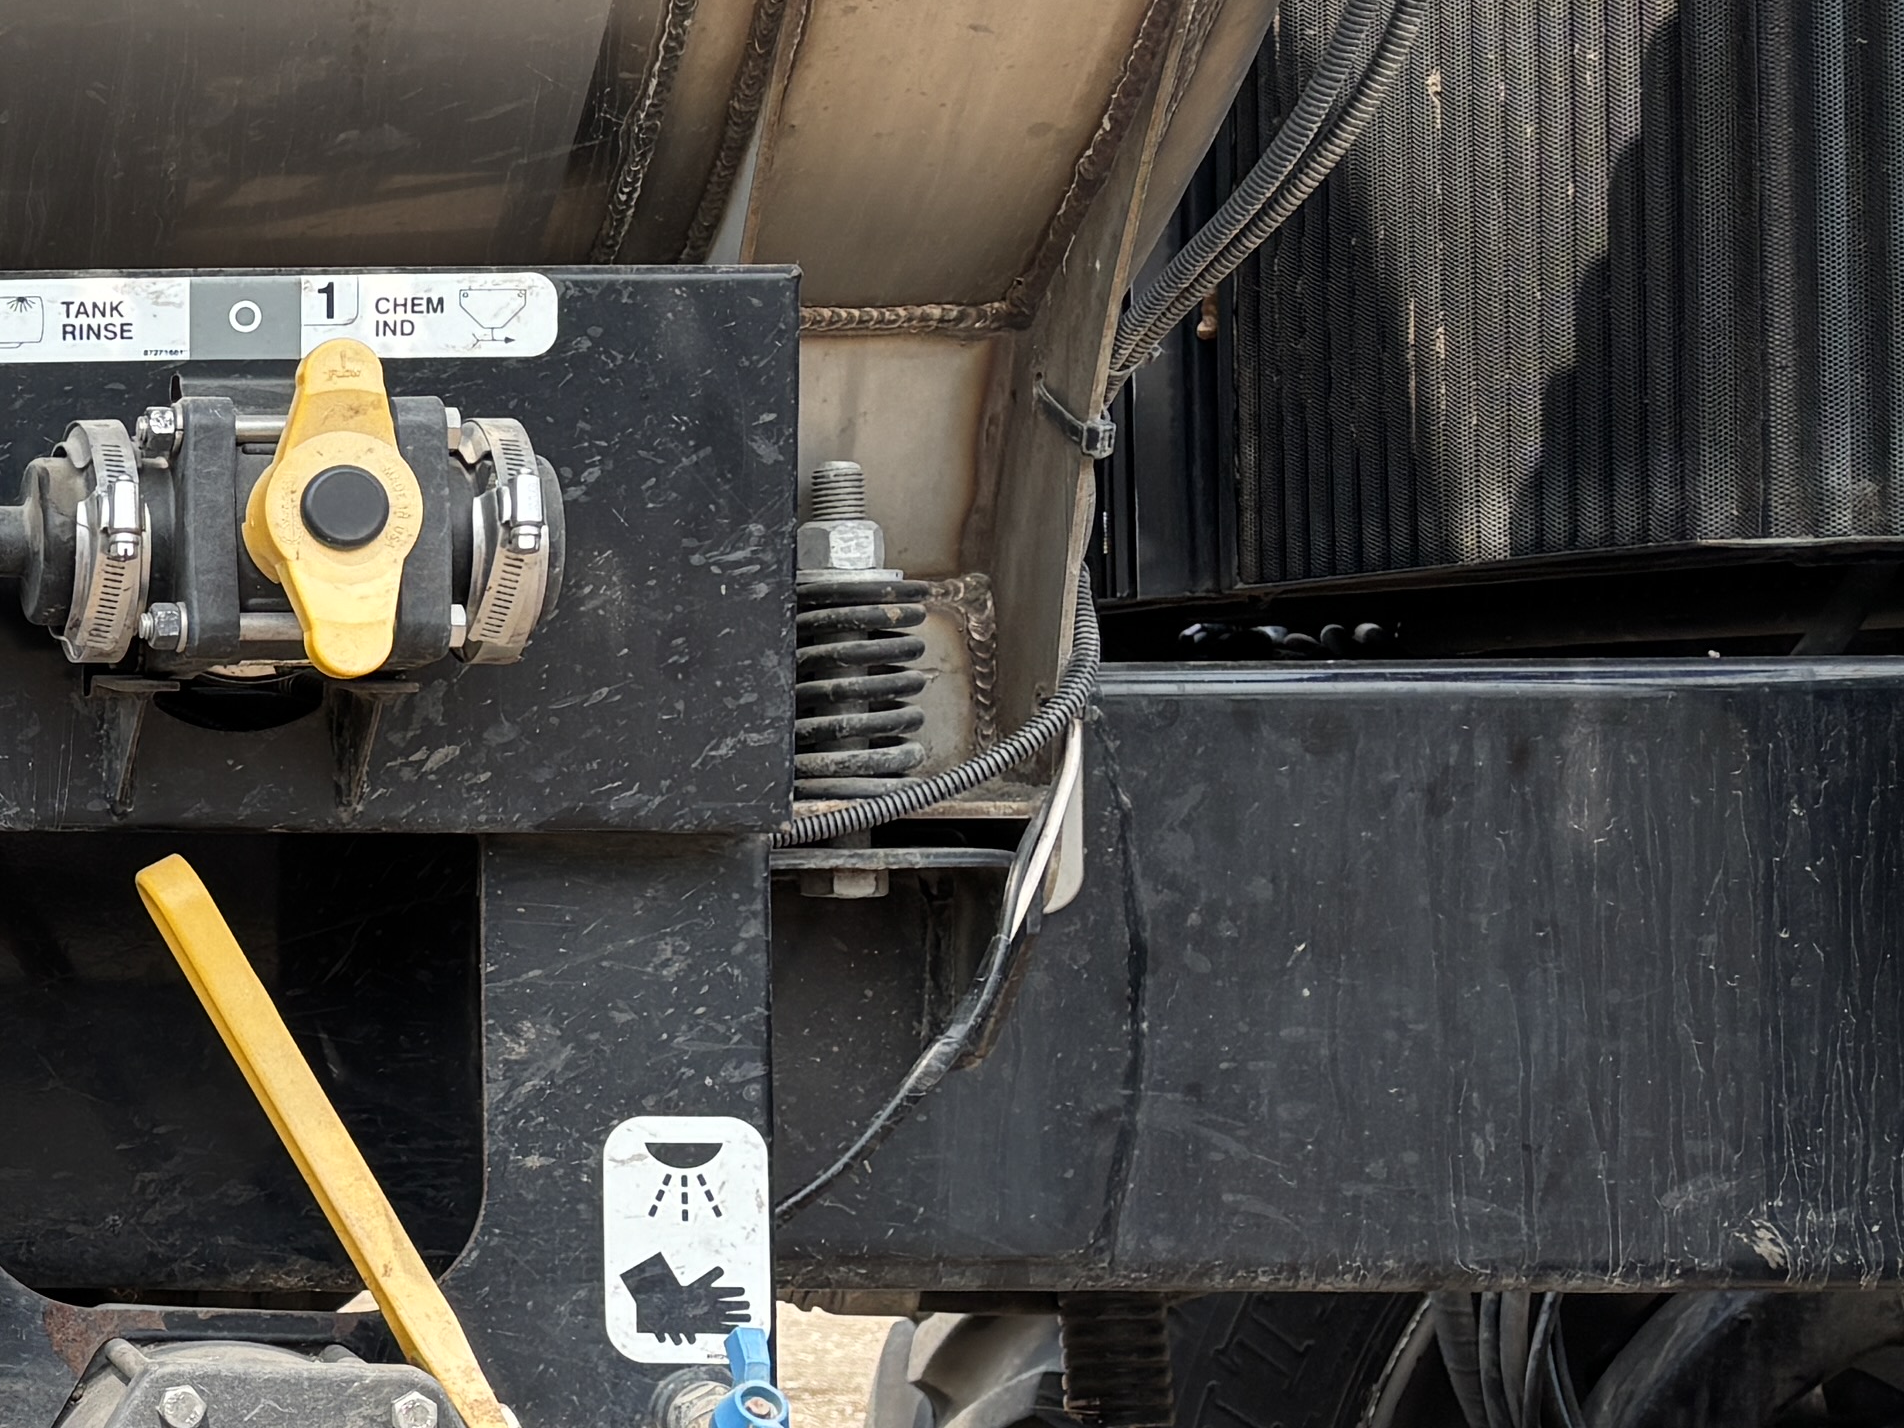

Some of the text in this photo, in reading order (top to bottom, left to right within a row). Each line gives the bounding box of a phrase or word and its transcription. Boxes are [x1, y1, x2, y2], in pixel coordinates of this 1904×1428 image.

[318, 282, 334, 319] 1
[375, 297, 444, 314] CHEM
[61, 301, 123, 318] TANK
[63, 323, 133, 341] RINSE
[376, 320, 414, 337] IND
